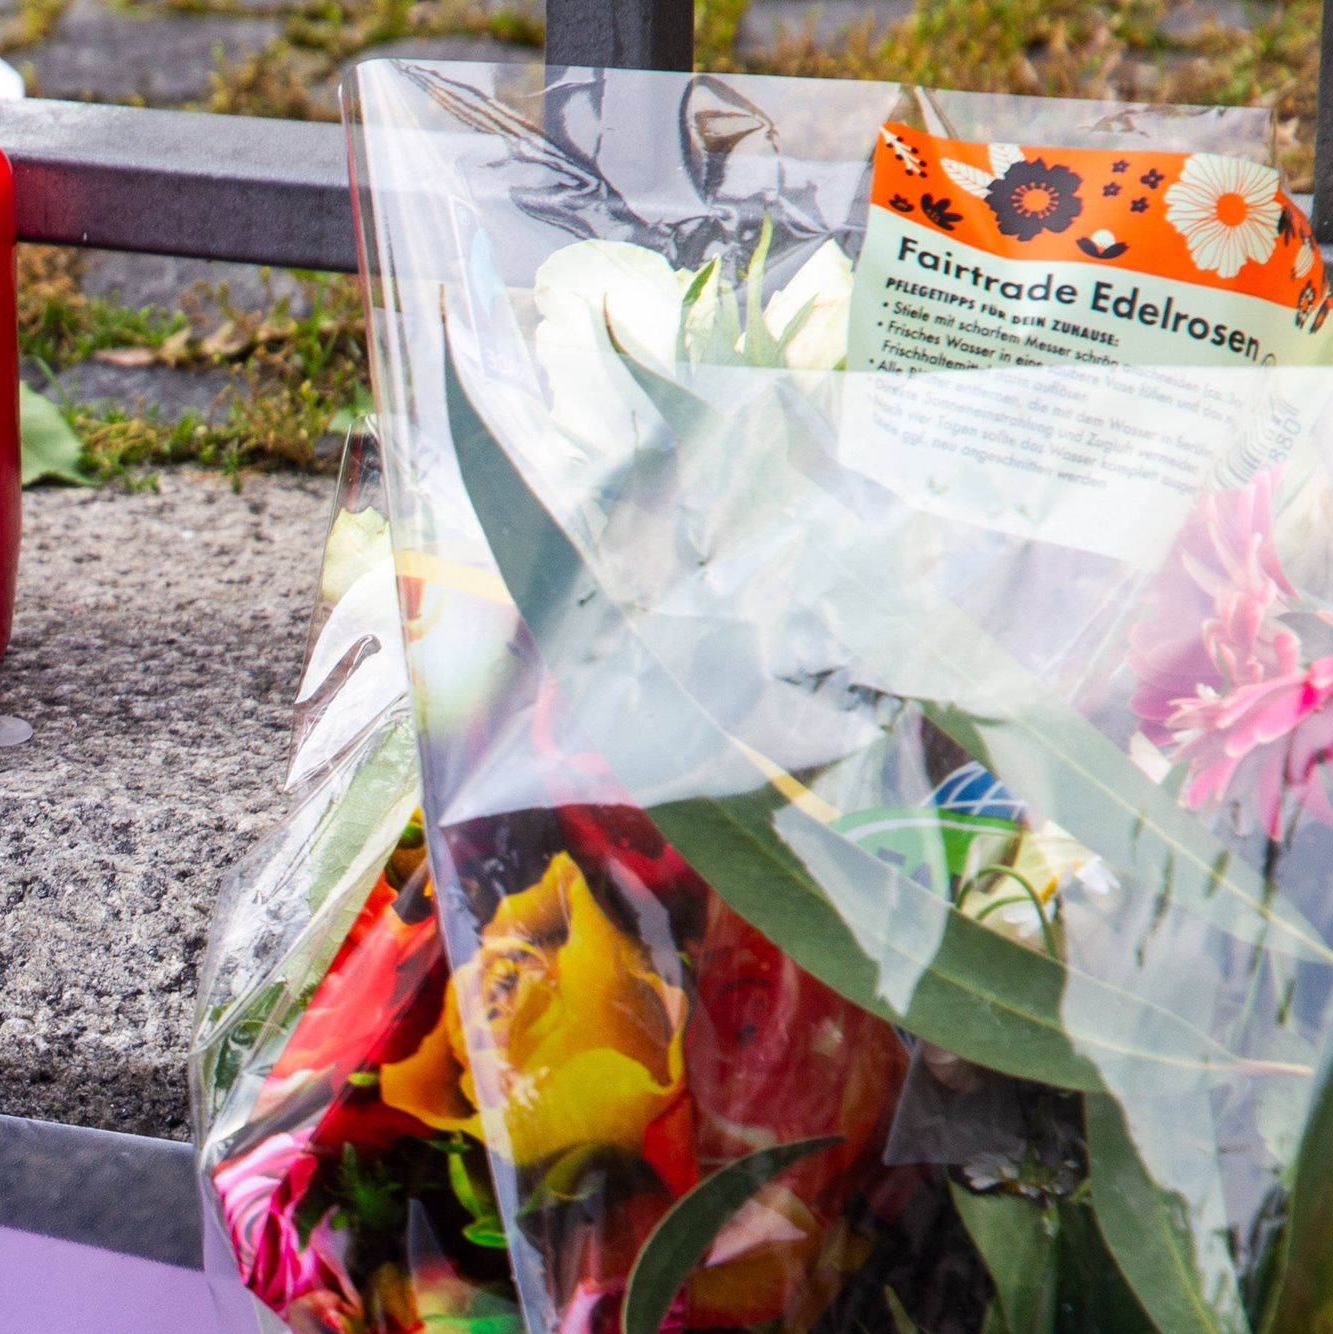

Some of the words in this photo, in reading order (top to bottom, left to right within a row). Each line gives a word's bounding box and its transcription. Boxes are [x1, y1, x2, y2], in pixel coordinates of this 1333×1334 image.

[885, 276, 976, 310] PFLEGETIPPS
[980, 301, 1006, 321] FÜR
[1011, 313, 1047, 327] DEIN
[1052, 318, 1120, 347] ZUHAUSE:
[893, 301, 930, 322] Stiele
[934, 312, 955, 328] mit
[958, 318, 1022, 345] scharfem
[1025, 334, 1072, 357] Messer
[896, 235, 1079, 304] Fairtrade
[1090, 280, 1261, 362] Edelrosen
[886, 320, 941, 345] Frisches
[945, 334, 995, 359] Wasser
[997, 345, 1012, 362] in
[878, 359, 904, 376] Alle
[1108, 416, 1157, 440] Wasser
[936, 414, 978, 436] Tagen
